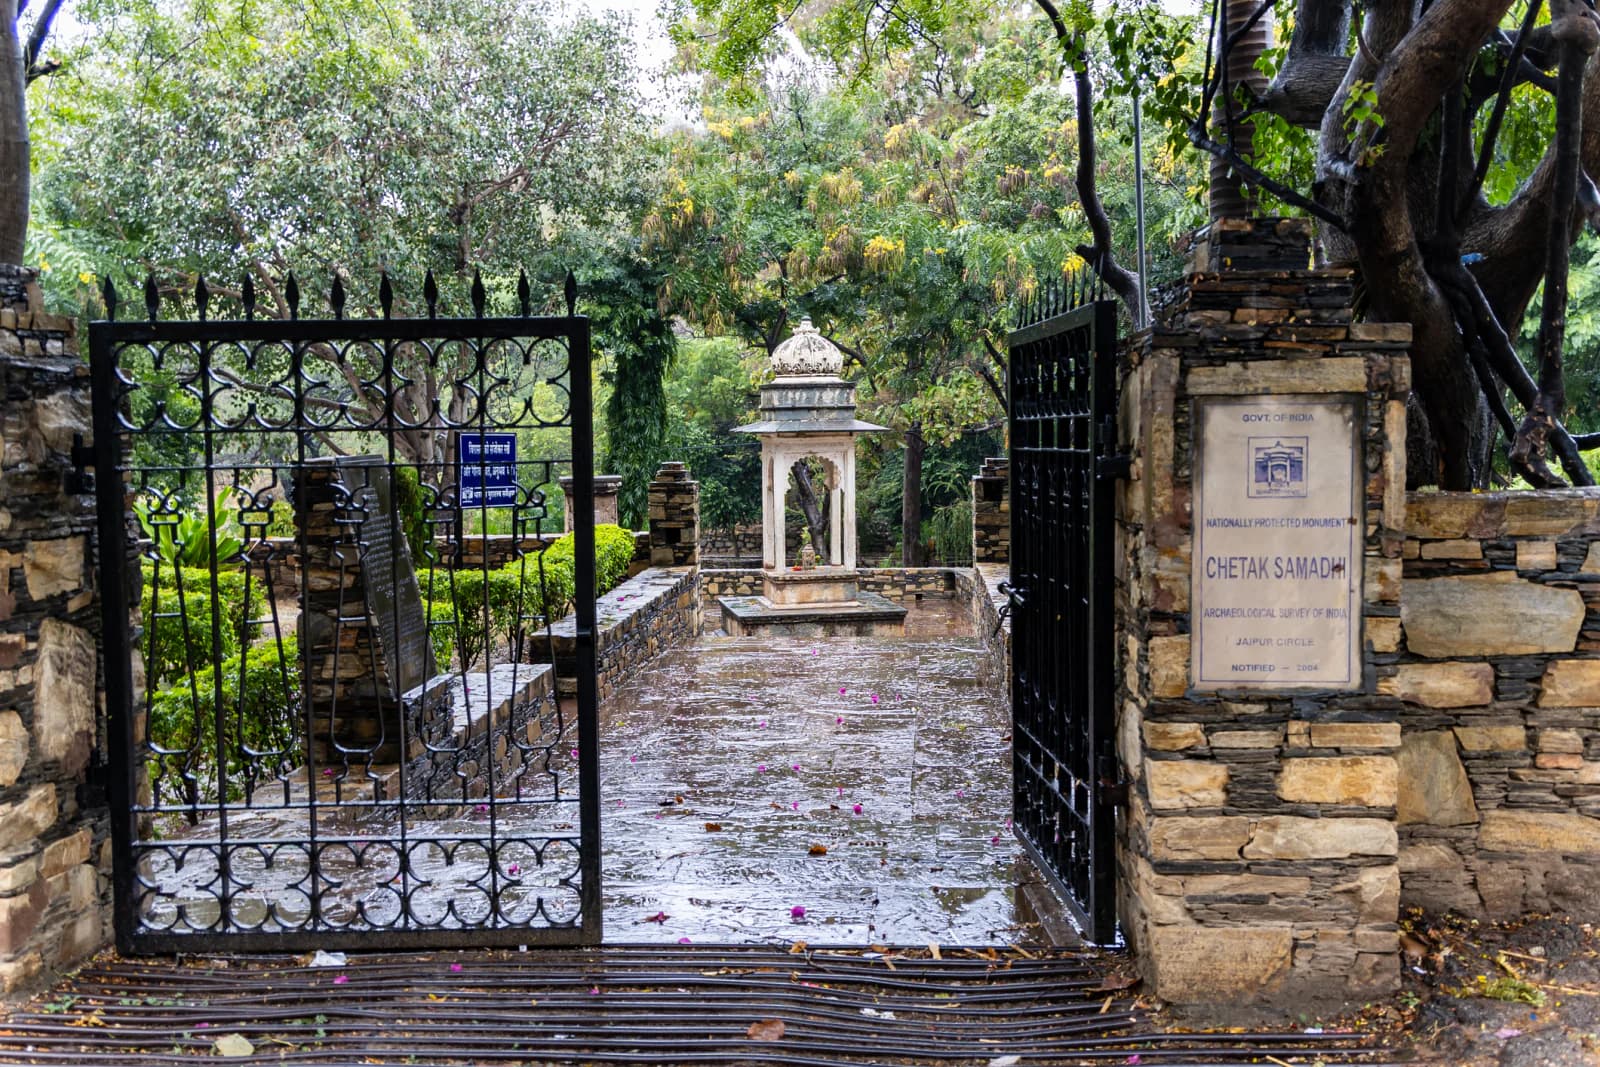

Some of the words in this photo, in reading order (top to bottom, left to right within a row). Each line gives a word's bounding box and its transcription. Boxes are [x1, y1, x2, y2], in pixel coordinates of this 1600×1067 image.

[1242, 413, 1271, 423] GOVT.
[1273, 413, 1288, 422] OF
[1289, 413, 1314, 422] INDIA
[1206, 518, 1252, 528] NATIONALLY
[1255, 518, 1301, 528] PROTECTED
[1302, 518, 1346, 528] MONUMENT
[1206, 556, 1269, 580] CHETAK
[1274, 556, 1346, 580] SAMADHI
[1204, 607, 1276, 618] ARCHAEOLOGICAL
[1279, 607, 1311, 618] SURVEY
[1313, 607, 1323, 618] OF
[1325, 607, 1348, 619] INDIA
[1236, 638, 1273, 647] JAIPUR
[1276, 638, 1315, 647] CIRCLE
[1231, 664, 1276, 672] NOTIFIED
